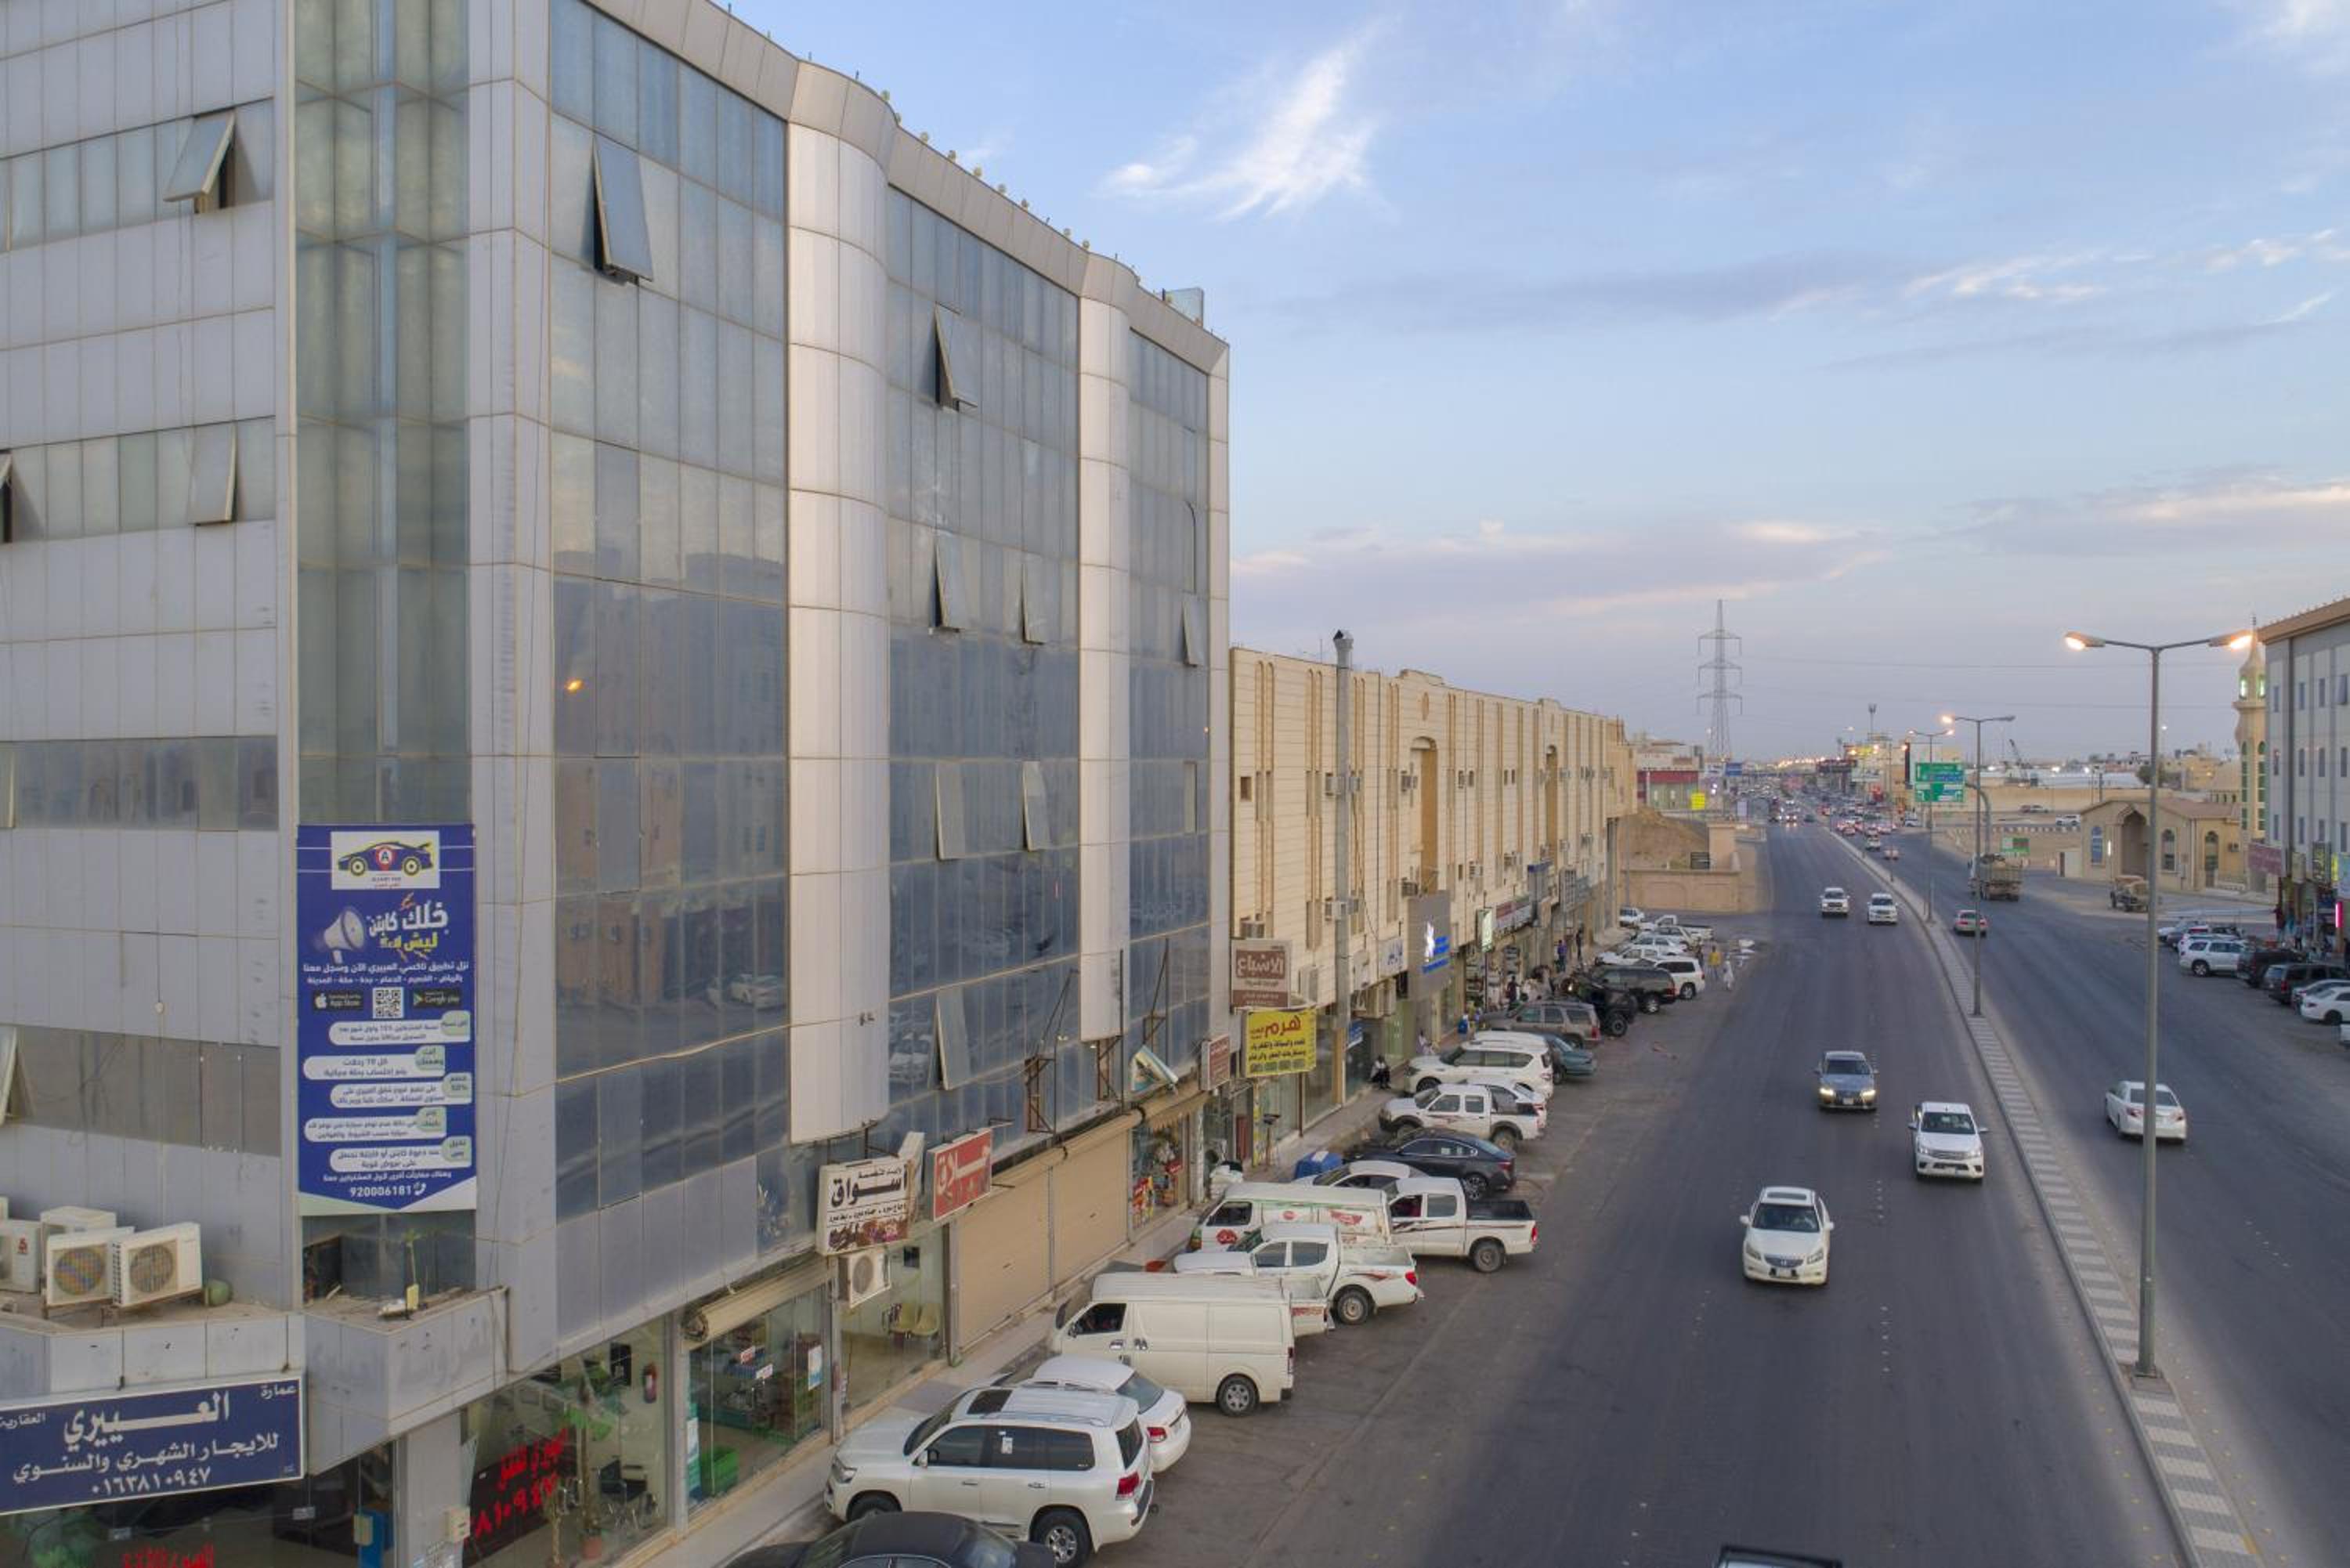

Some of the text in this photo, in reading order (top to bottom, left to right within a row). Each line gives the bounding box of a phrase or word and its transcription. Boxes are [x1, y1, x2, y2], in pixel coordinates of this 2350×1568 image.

[402, 900, 448, 930] خلك
[403, 931, 438, 952] ليش
[261, 1384, 298, 1400] عمارة
[13, 1454, 110, 1484] والسنوي
[117, 1442, 195, 1471] الشهري
[92, 1466, 212, 1496] ٠١٦٣٨١٠٩٤٧
